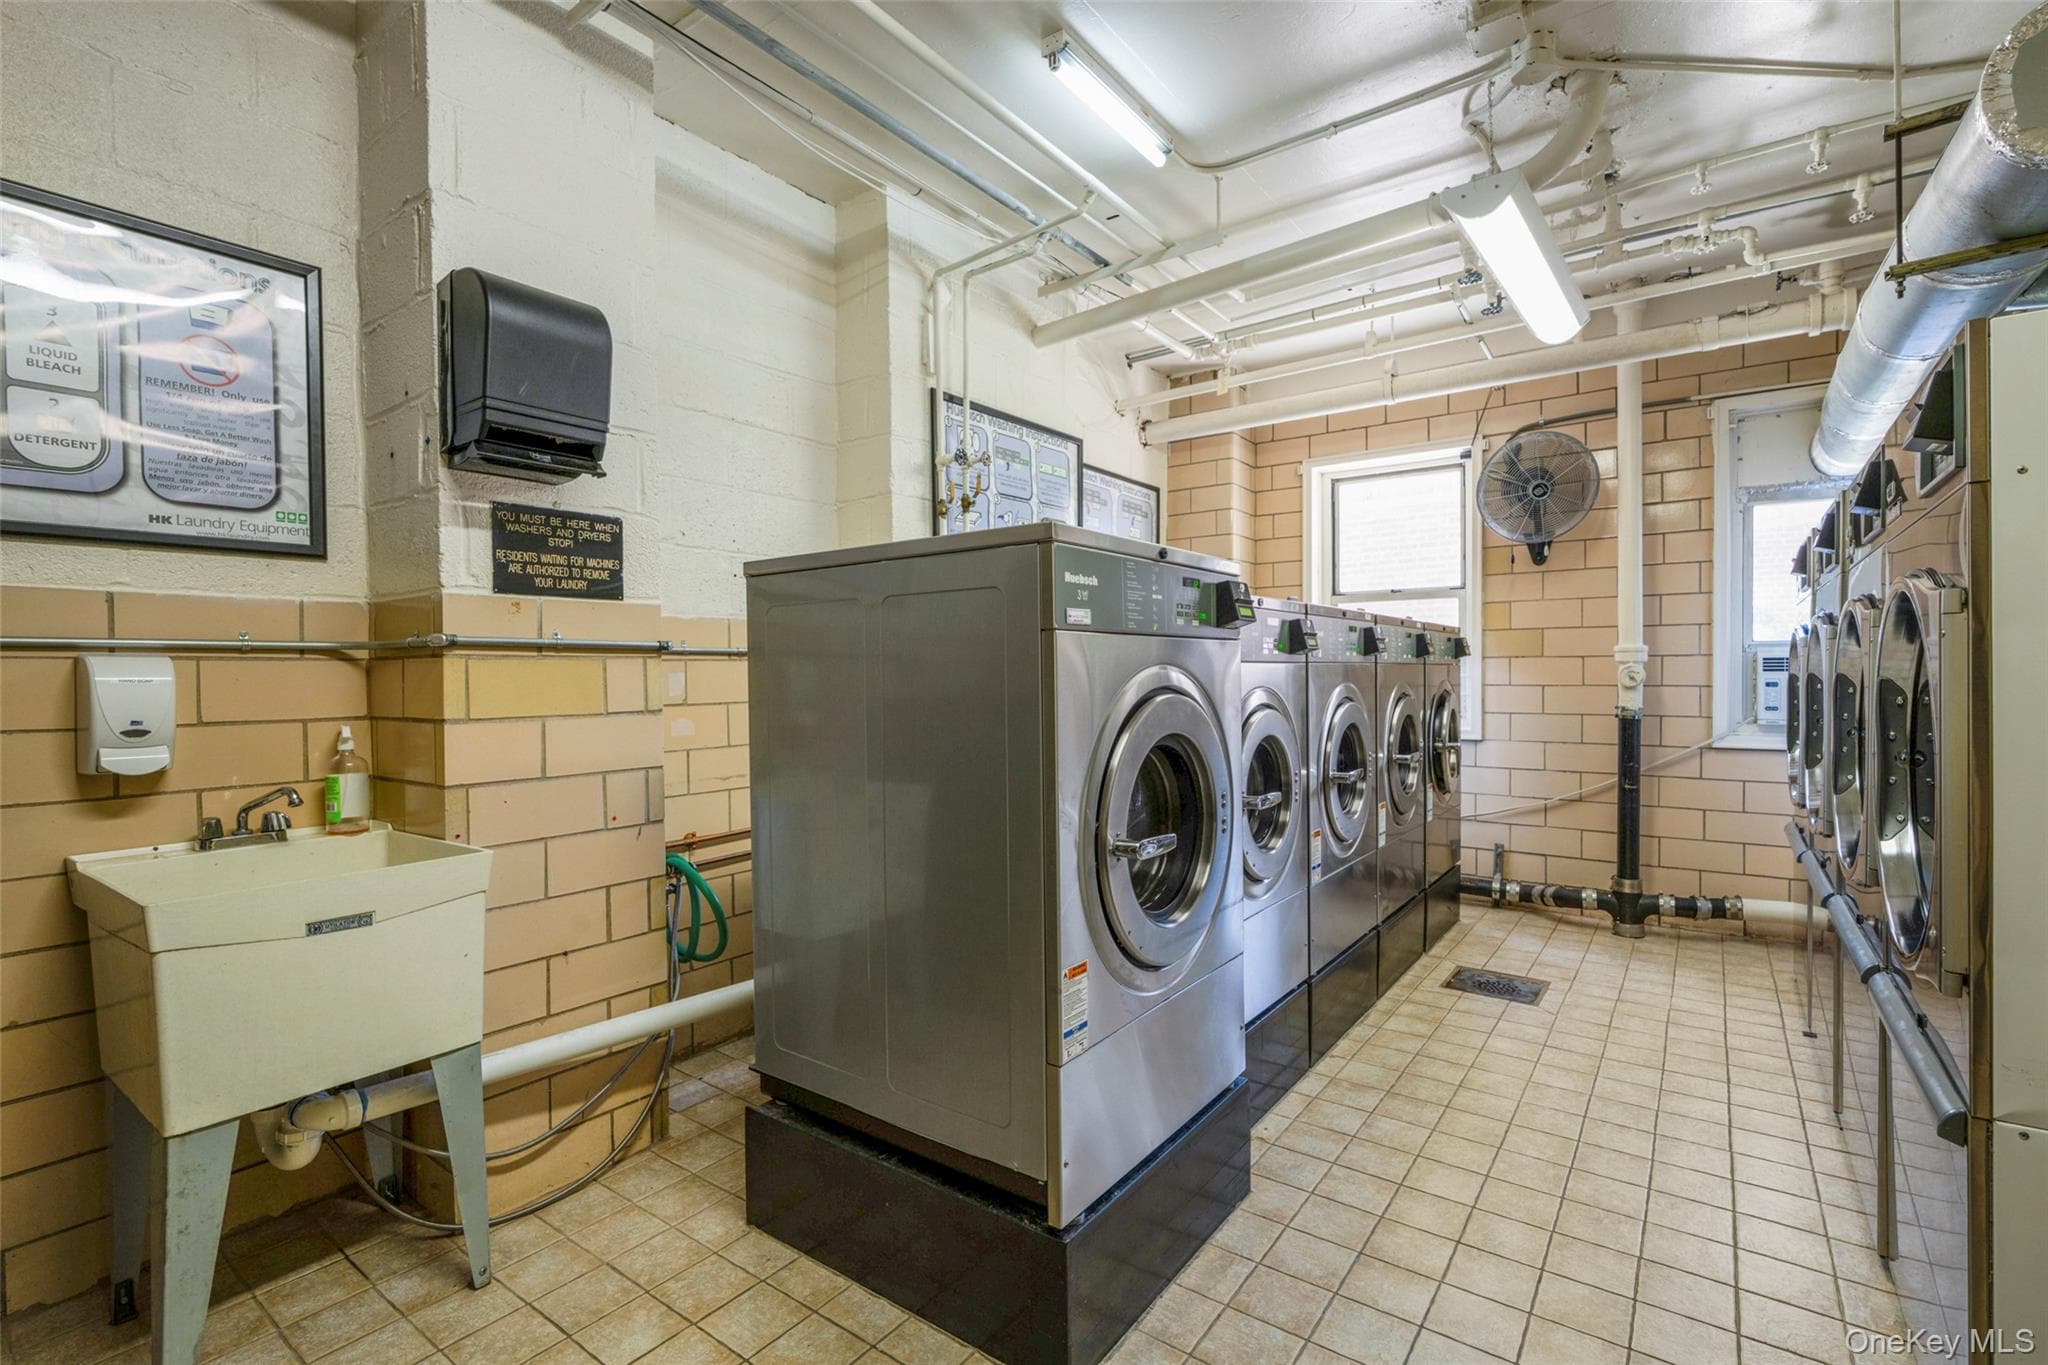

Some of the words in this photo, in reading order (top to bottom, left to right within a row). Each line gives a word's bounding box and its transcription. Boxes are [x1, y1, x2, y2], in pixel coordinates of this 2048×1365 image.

[28, 344, 78, 361] LIQUID
[26, 357, 82, 375] BLEACH
[145, 376, 216, 396] REMEMBER!
[221, 390, 247, 402] Only
[220, 431, 227, 439] A
[988, 415, 1024, 440] Washing
[14, 432, 98, 451] DETERGENT
[177, 453, 198, 463] taza
[201, 455, 214, 464] de
[148, 513, 173, 526] HK
[176, 513, 236, 534] Laundry
[240, 519, 311, 538] Equipment
[495, 510, 516, 521] YOU
[520, 513, 547, 524] MUST
[550, 516, 563, 526] BE
[566, 519, 591, 531] HERE
[594, 522, 620, 533] WHEN
[505, 523, 553, 536] WASHERS
[556, 528, 575, 539] AND
[577, 530, 612, 543] DRYERS
[495, 549, 538, 563] RESIDENTS
[540, 553, 568, 566] WAITING
[570, 556, 585, 567] FOR
[587, 558, 620, 570] MACHINES
[507, 562, 524, 574] ARE
[526, 564, 570, 578] AUTHORIZED
[571, 567, 582, 578] TO
[583, 569, 611, 581] REMOVE
[1064, 571, 1099, 586] Huebsch
[534, 577, 554, 588] YOUR
[556, 579, 589, 590] LAUNDRY
